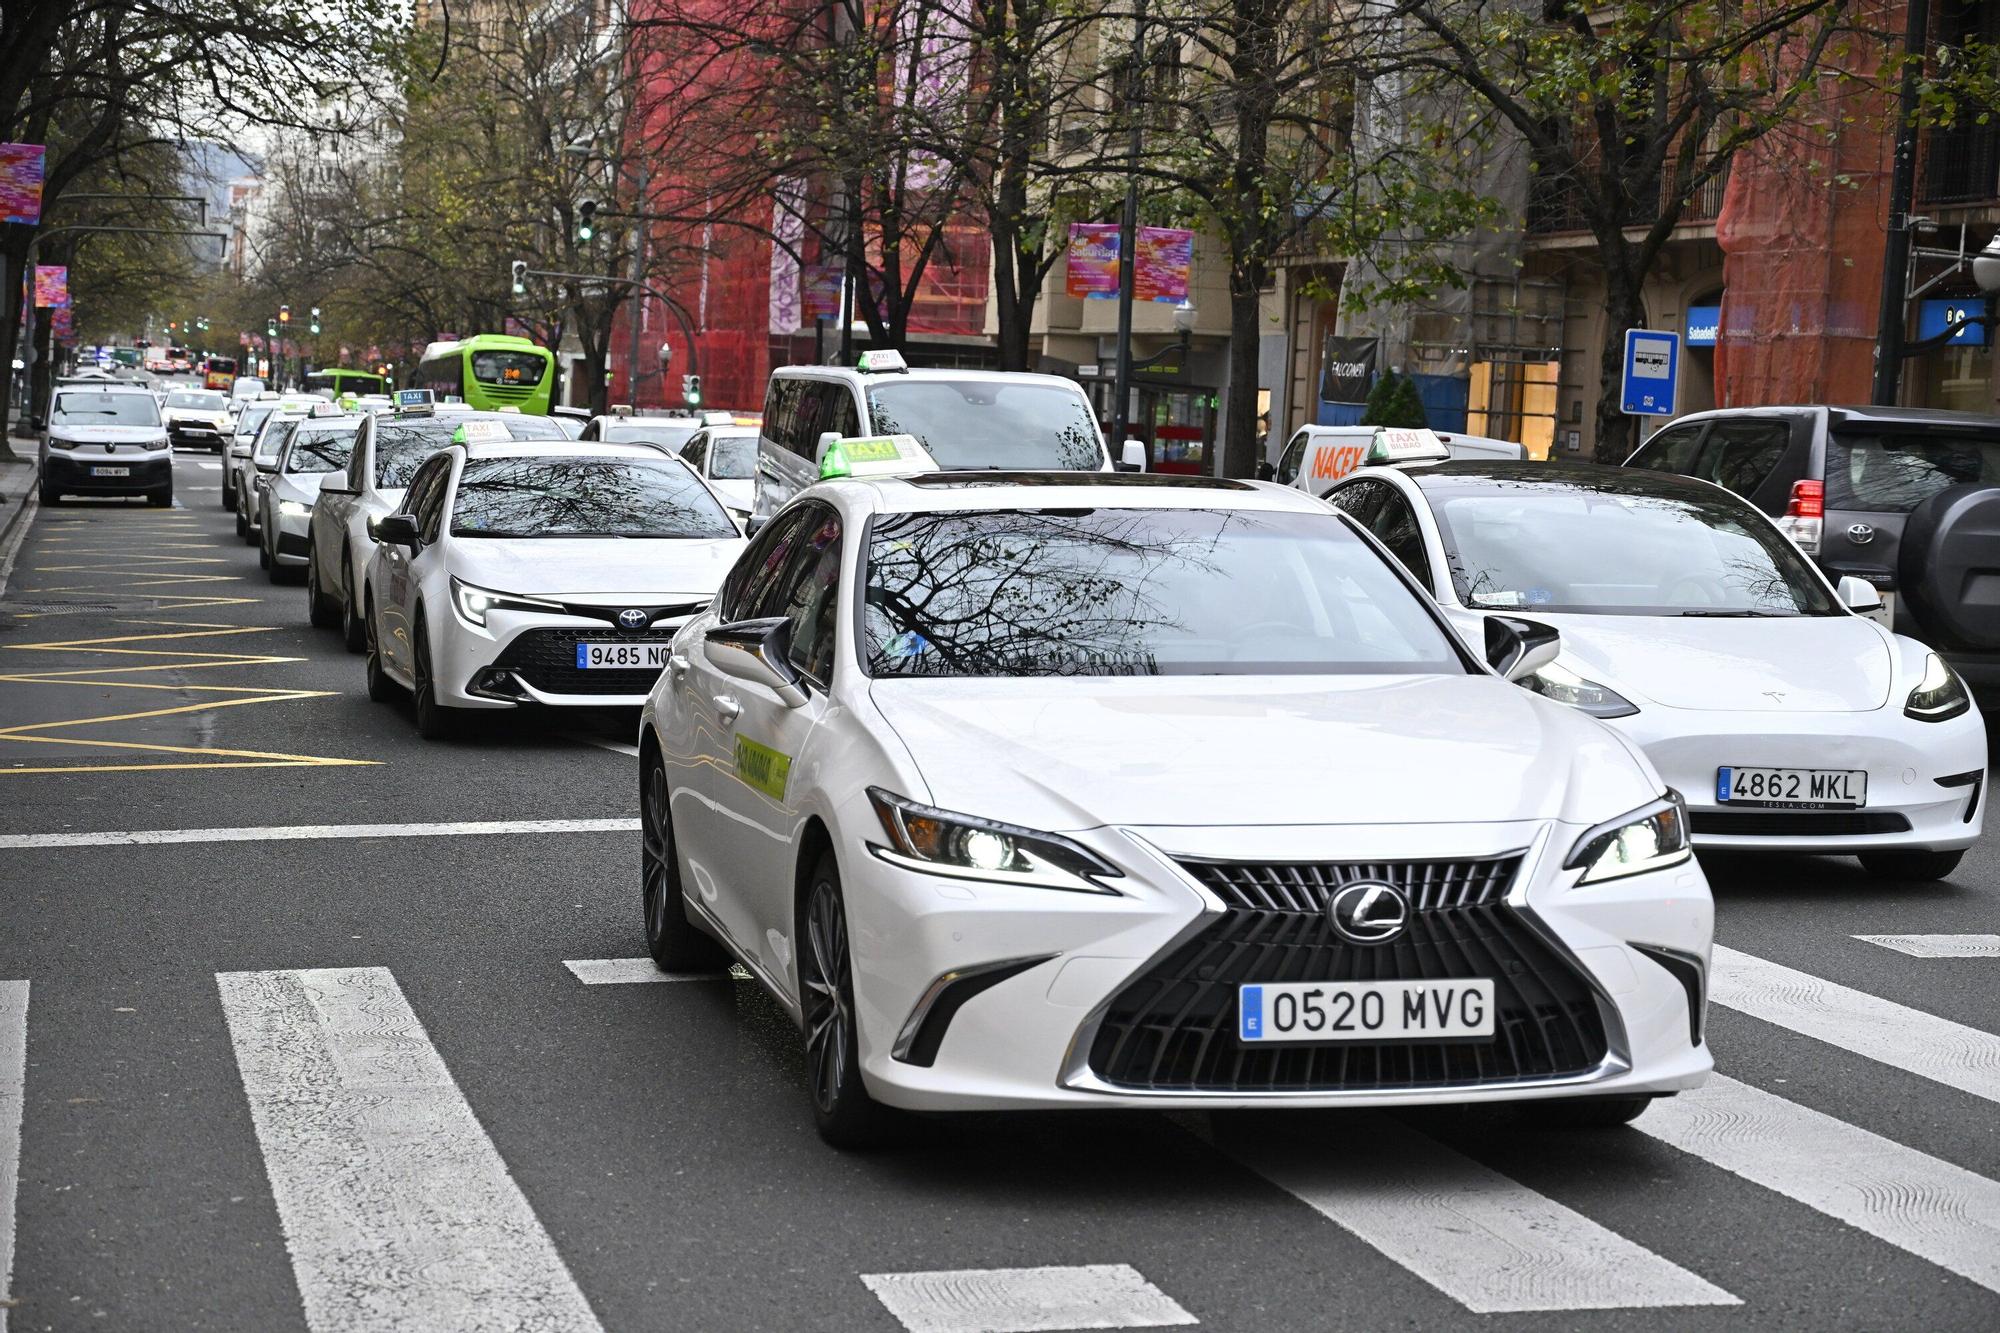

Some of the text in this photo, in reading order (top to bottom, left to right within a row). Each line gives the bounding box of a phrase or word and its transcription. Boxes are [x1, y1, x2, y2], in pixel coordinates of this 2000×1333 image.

[1070, 246, 1118, 260] Saturday
[467, 424, 489, 432] TAXI
[1386, 432, 1419, 443] TAXI
[844, 441, 894, 456] TAXI
[1311, 447, 1364, 480] NACEX
[591, 647, 640, 665] 9485
[1734, 772, 1801, 798] 4862
[1810, 774, 1856, 799] MKL
[1762, 801, 1825, 809] TESLA.COM
[1247, 988, 1483, 1033] E 0520 MVG
